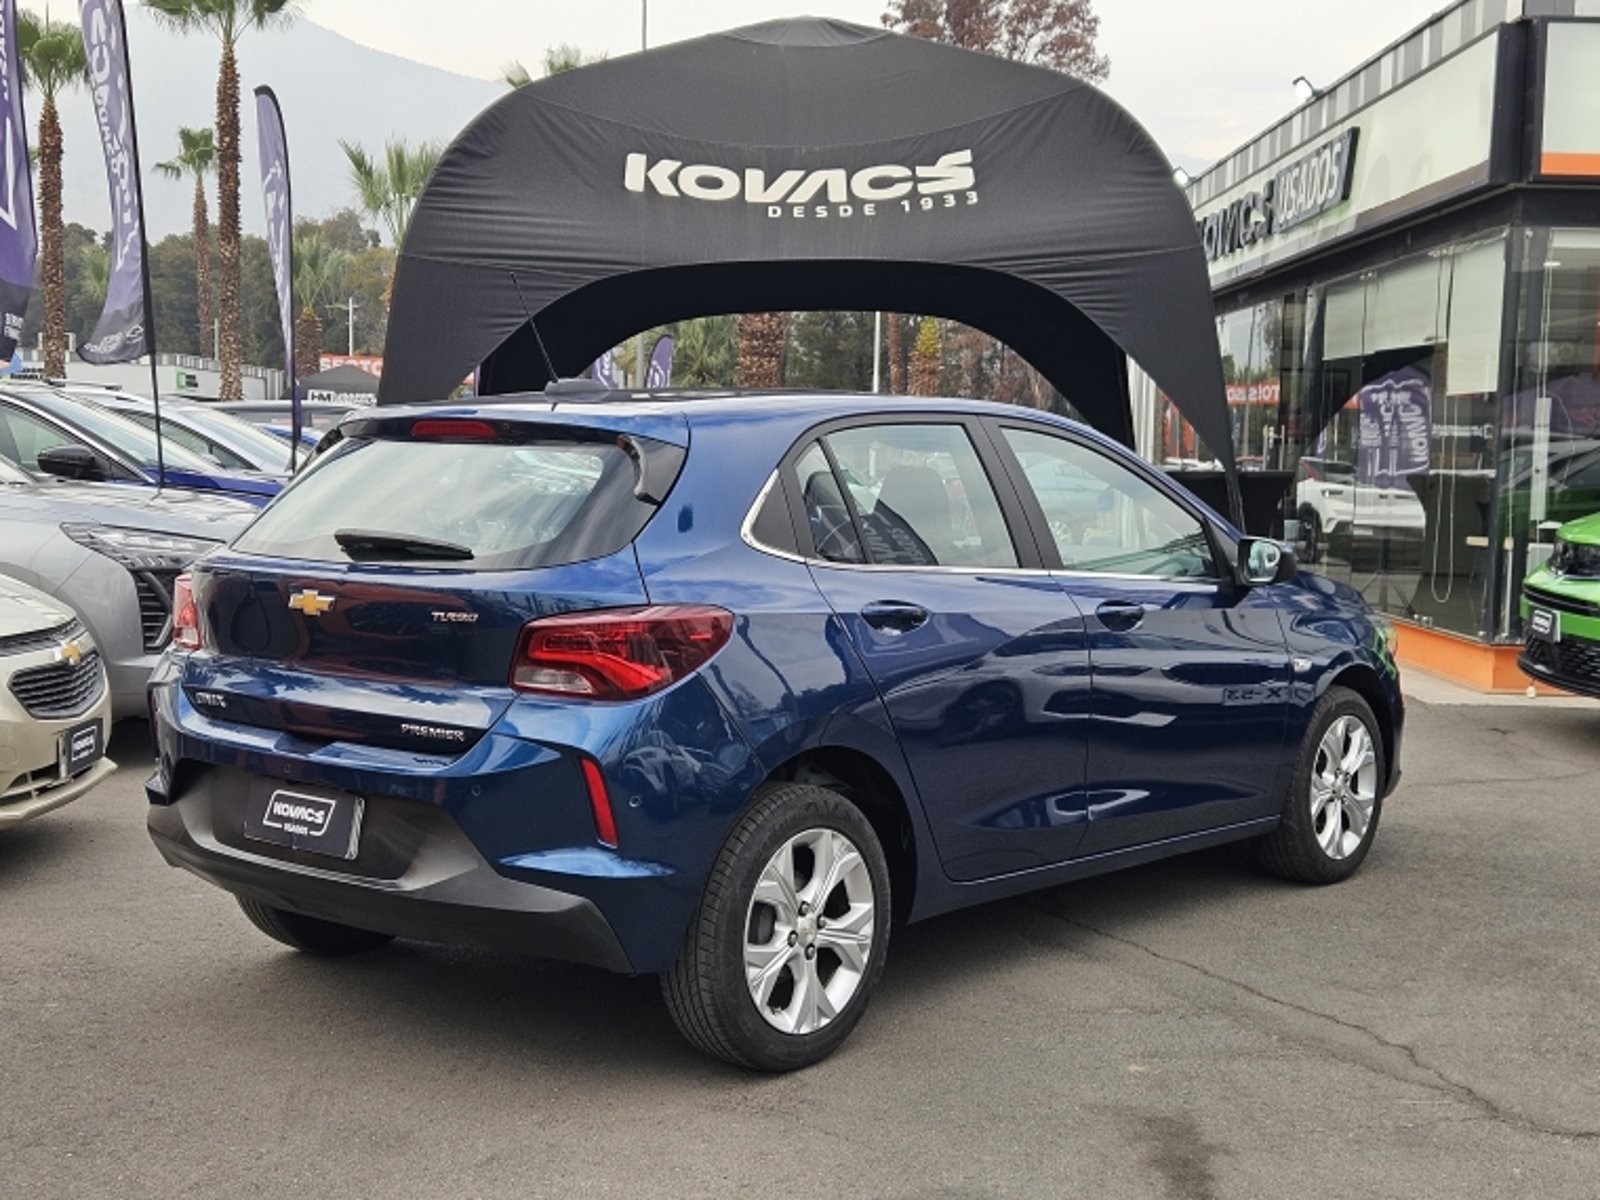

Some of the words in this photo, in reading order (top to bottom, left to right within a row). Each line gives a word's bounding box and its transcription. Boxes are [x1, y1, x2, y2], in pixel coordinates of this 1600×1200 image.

[624, 149, 975, 203] KOVACS
[1279, 141, 1343, 224] USADOS
[767, 203, 876, 218] DESDE
[900, 191, 979, 213] 1933
[431, 611, 479, 622] TURBO
[401, 723, 465, 742] PREMIER
[273, 801, 325, 824] KOVACS
